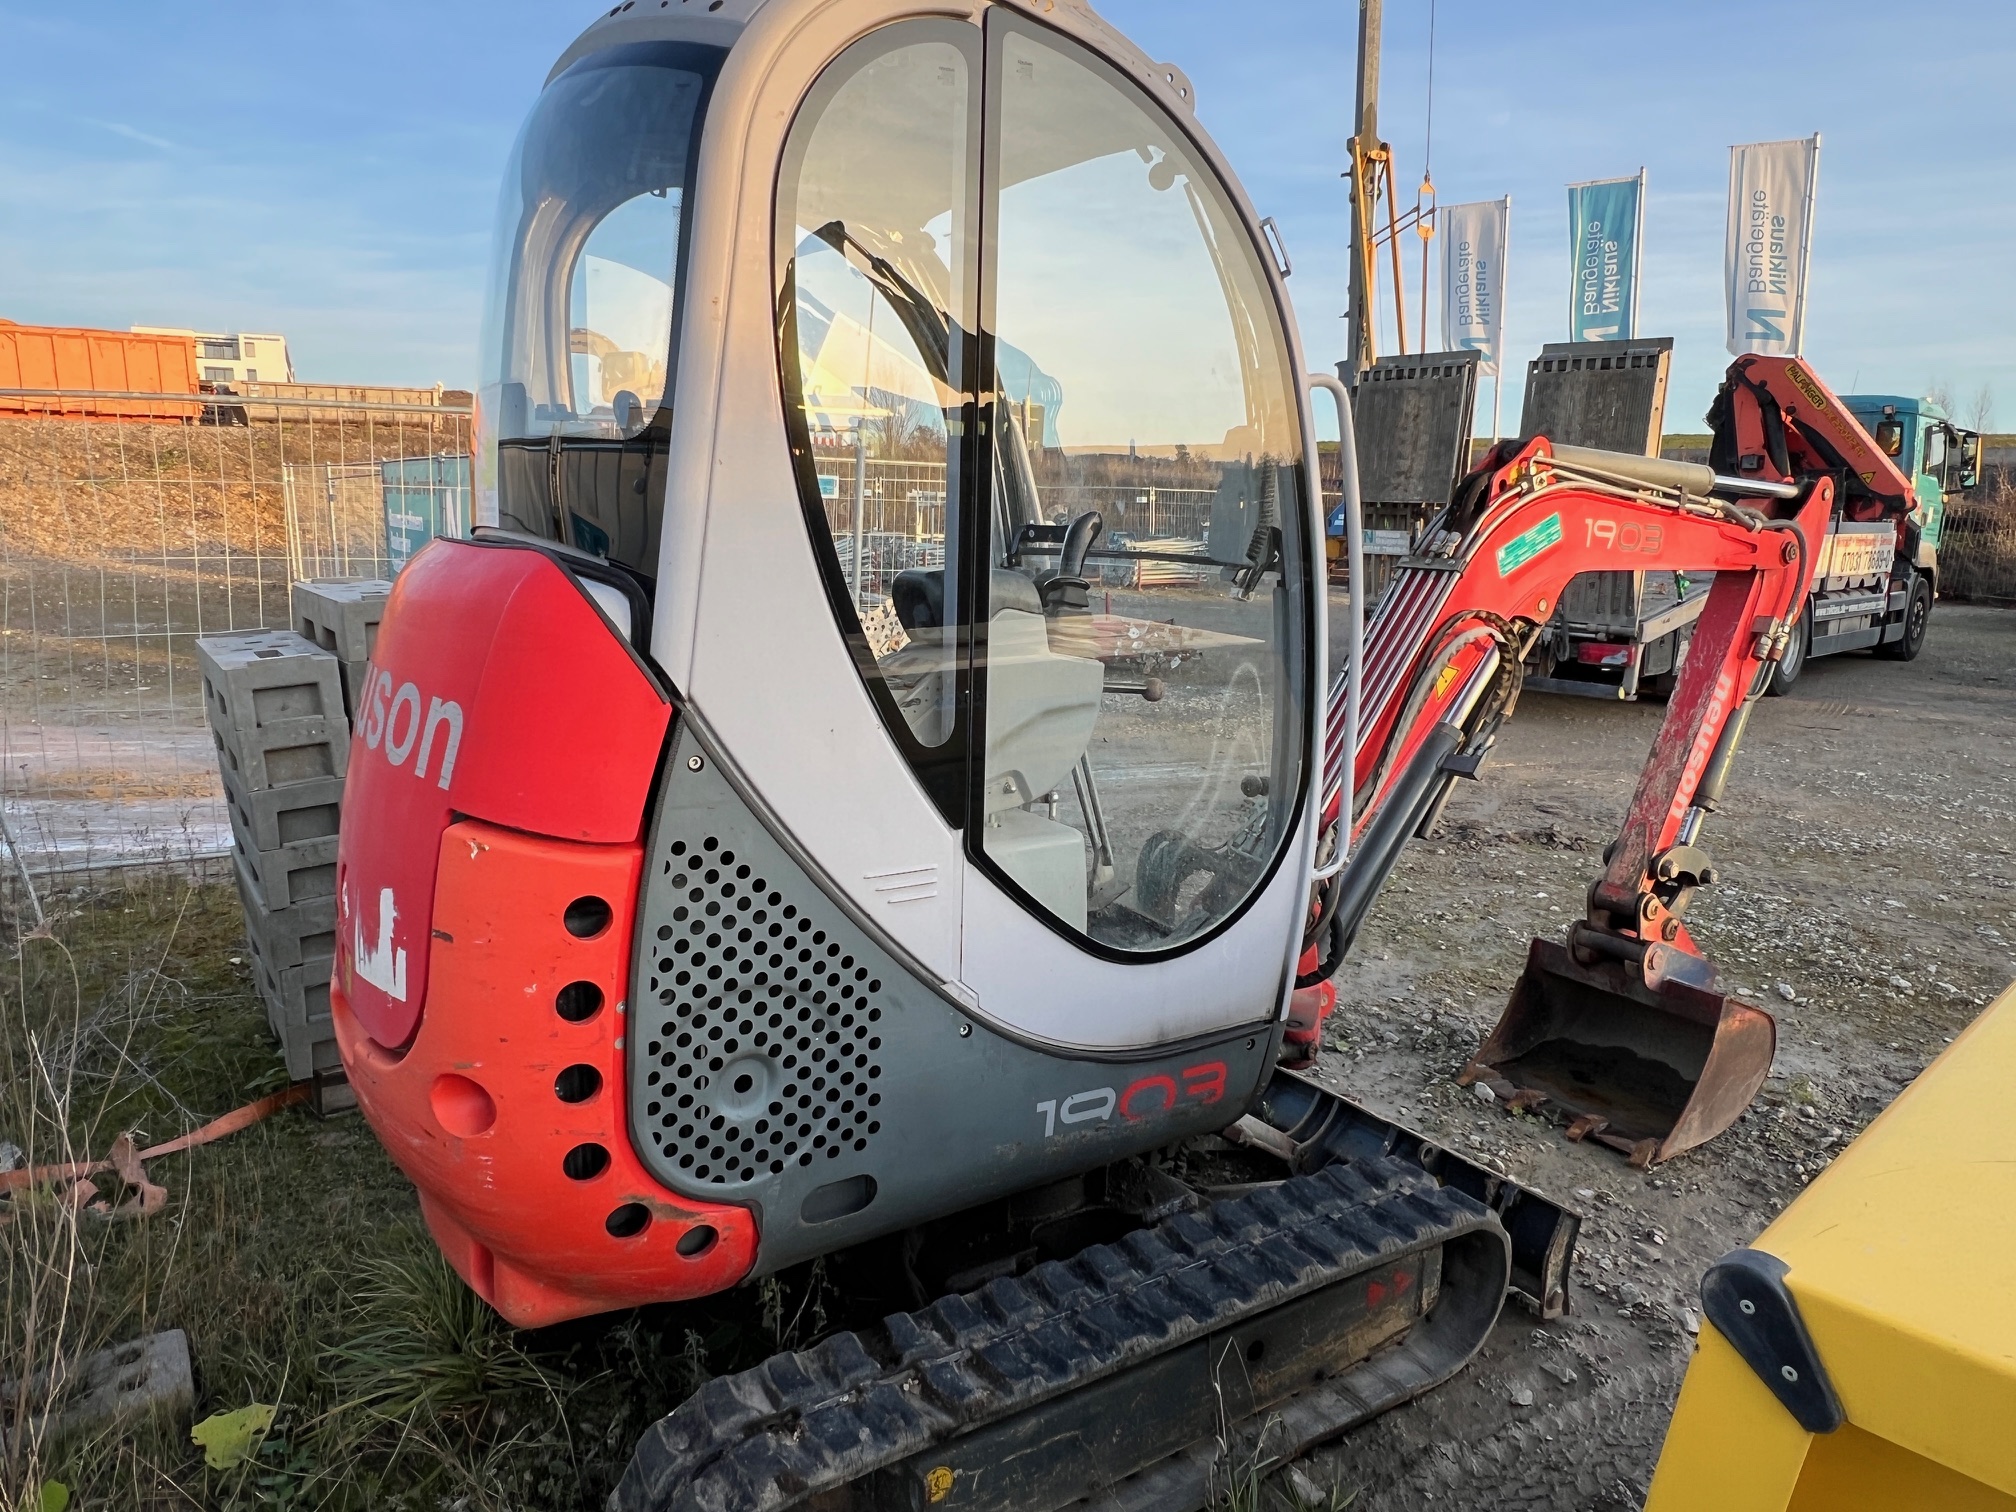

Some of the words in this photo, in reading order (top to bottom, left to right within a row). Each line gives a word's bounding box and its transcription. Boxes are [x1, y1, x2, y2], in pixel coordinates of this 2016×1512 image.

[1787, 365, 1824, 408] PALFINGER
[1585, 518, 1663, 554] 1903
[1671, 674, 1732, 820] neuson
[1036, 1061, 1228, 1138] 1903
